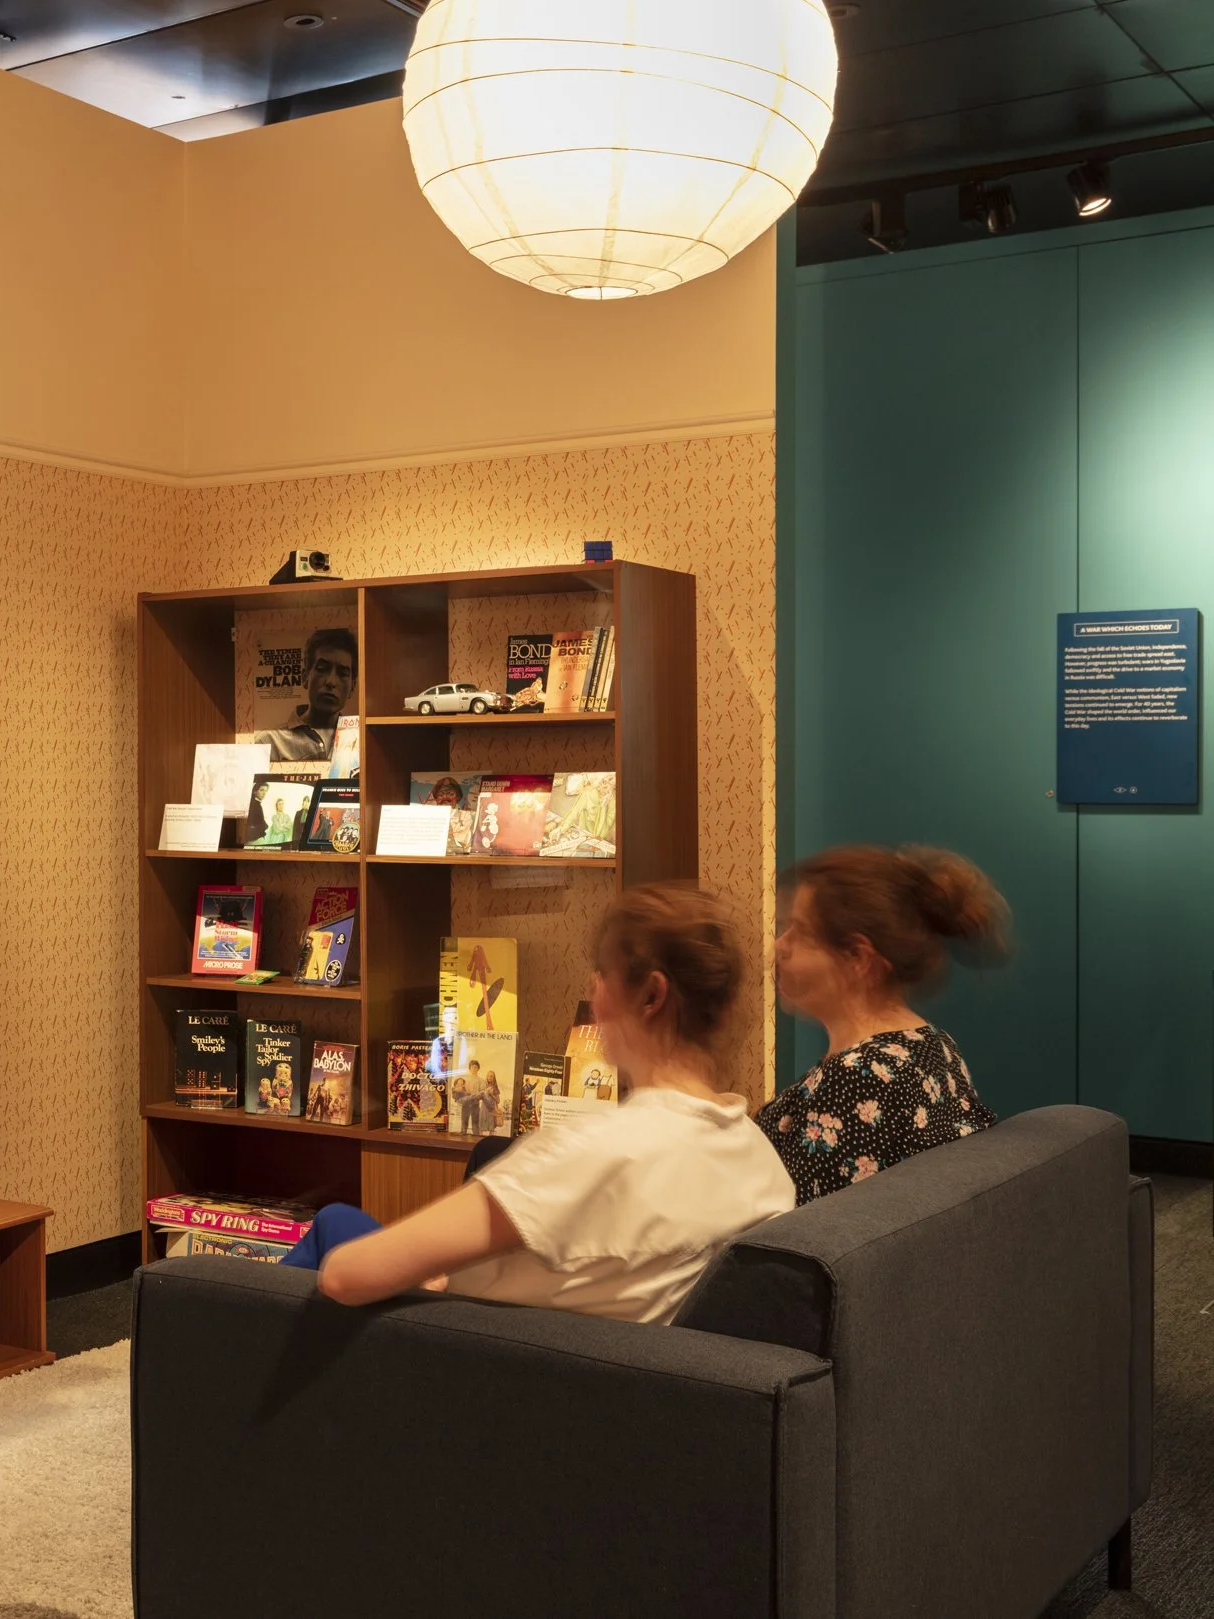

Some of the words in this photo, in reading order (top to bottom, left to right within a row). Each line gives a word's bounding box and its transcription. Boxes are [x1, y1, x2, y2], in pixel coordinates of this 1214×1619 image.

[1124, 624, 1150, 632] ECHOES
[1150, 623, 1173, 631] TODAY
[552, 638, 594, 648] JAMES
[509, 643, 552, 659] BOND
[273, 664, 302, 676] BOB
[256, 675, 302, 688] DYLAN
[438, 952, 458, 1036] CHMEN
[188, 1016, 200, 1025] LE
[201, 1015, 229, 1025] CARRÉ
[255, 1024, 268, 1033] LE
[269, 1023, 297, 1034] CARRÉ
[191, 1035, 225, 1045] Smiley's
[497, 1033, 513, 1041] LAND
[262, 1038, 291, 1047] Tinker
[197, 1043, 226, 1053] People
[255, 1044, 279, 1054] Tailor
[256, 1057, 272, 1067] Spy
[264, 1052, 293, 1062] Soldier
[313, 1058, 351, 1072] BABYLON
[401, 1072, 441, 1080] DOCTO
[398, 1083, 445, 1092] ZHIVAGO
[190, 1210, 222, 1226] SPY
[220, 1215, 260, 1232] RING
